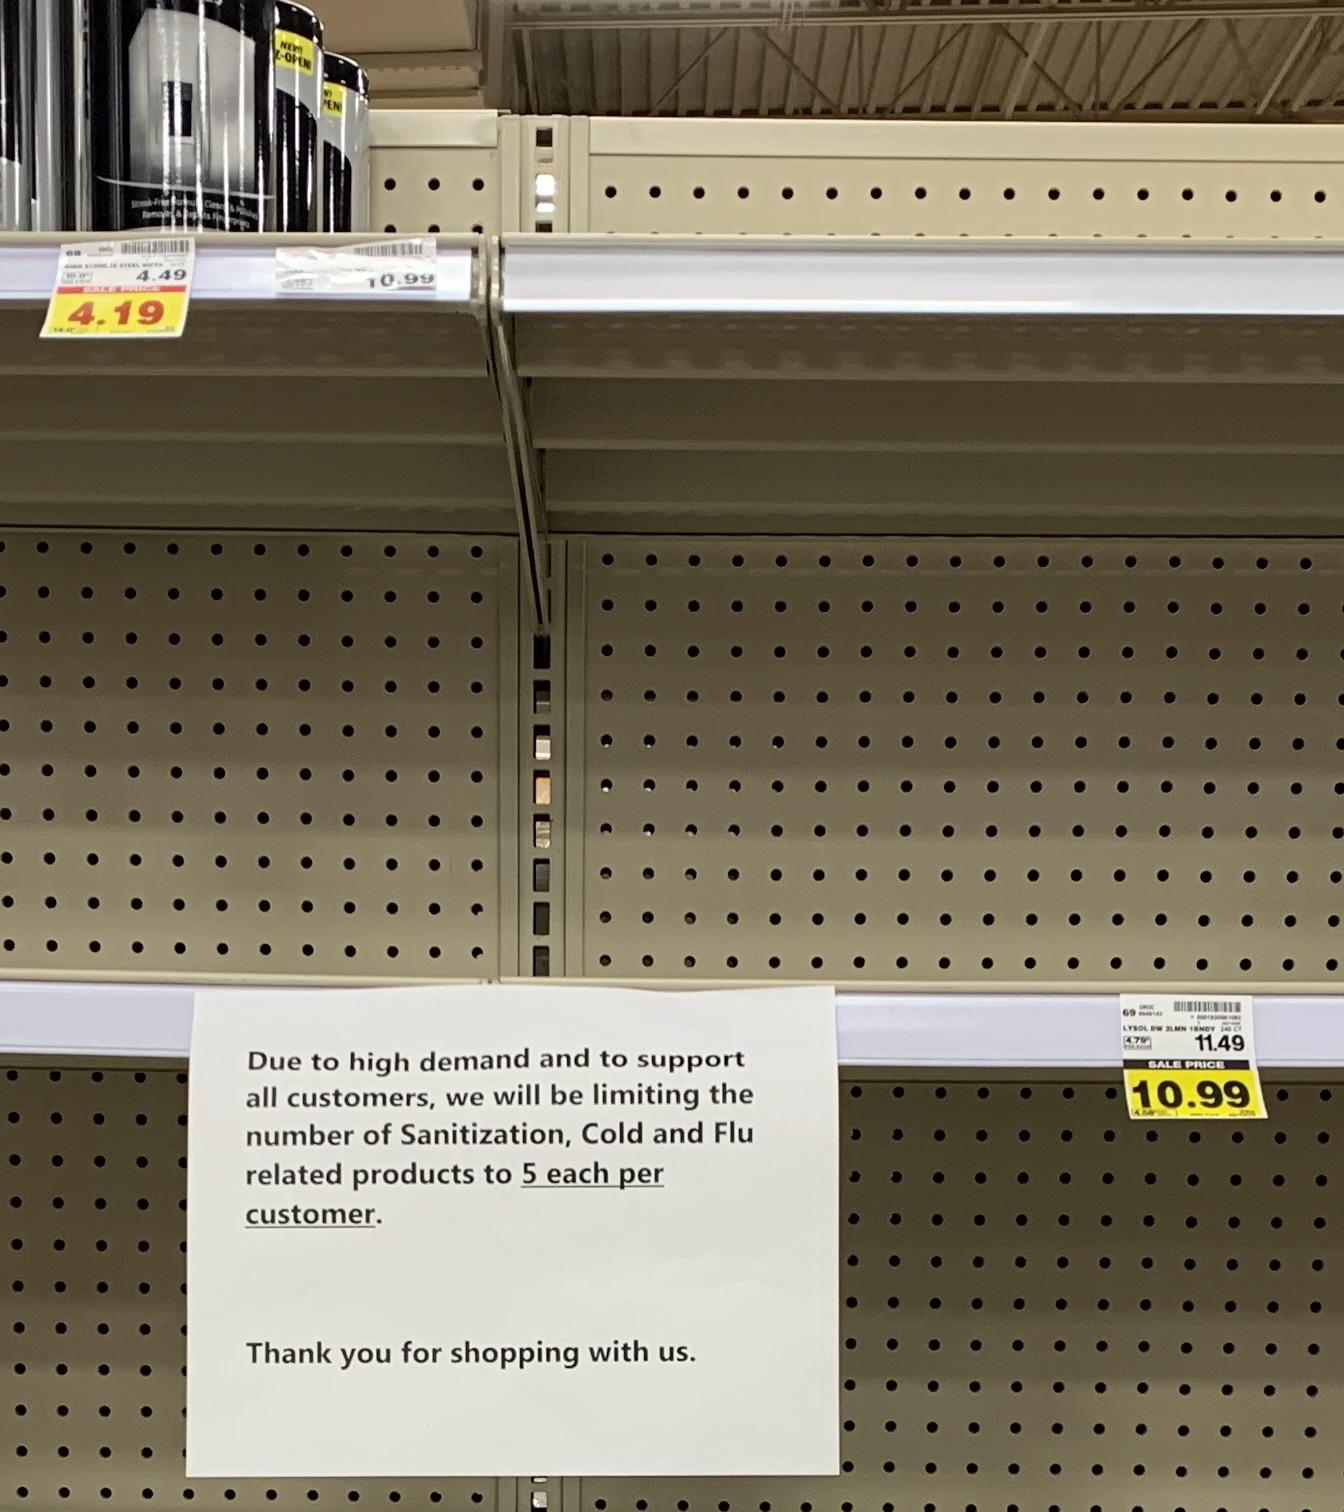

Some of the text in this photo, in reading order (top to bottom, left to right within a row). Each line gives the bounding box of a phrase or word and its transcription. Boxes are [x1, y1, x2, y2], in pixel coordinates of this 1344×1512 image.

[135, 269, 188, 283] 4.49
[366, 272, 435, 289] 10.99
[67, 299, 165, 326] 4.19
[1122, 1009, 1136, 1017] 69
[1195, 1034, 1245, 1052] 11.49
[248, 1047, 745, 1077] Due to high demand and to support
[1148, 1060, 1226, 1069] SALE PRICE
[246, 1082, 754, 1111] all customers, we will be limiting the
[1131, 1080, 1250, 1109] 10.99
[246, 1120, 754, 1148] number of Sanitization, Cold and Flu
[246, 1161, 665, 1191] related products to 5 each per
[246, 1205, 383, 1226] customer.
[246, 1339, 697, 1370] Thank you for shopping with us.
